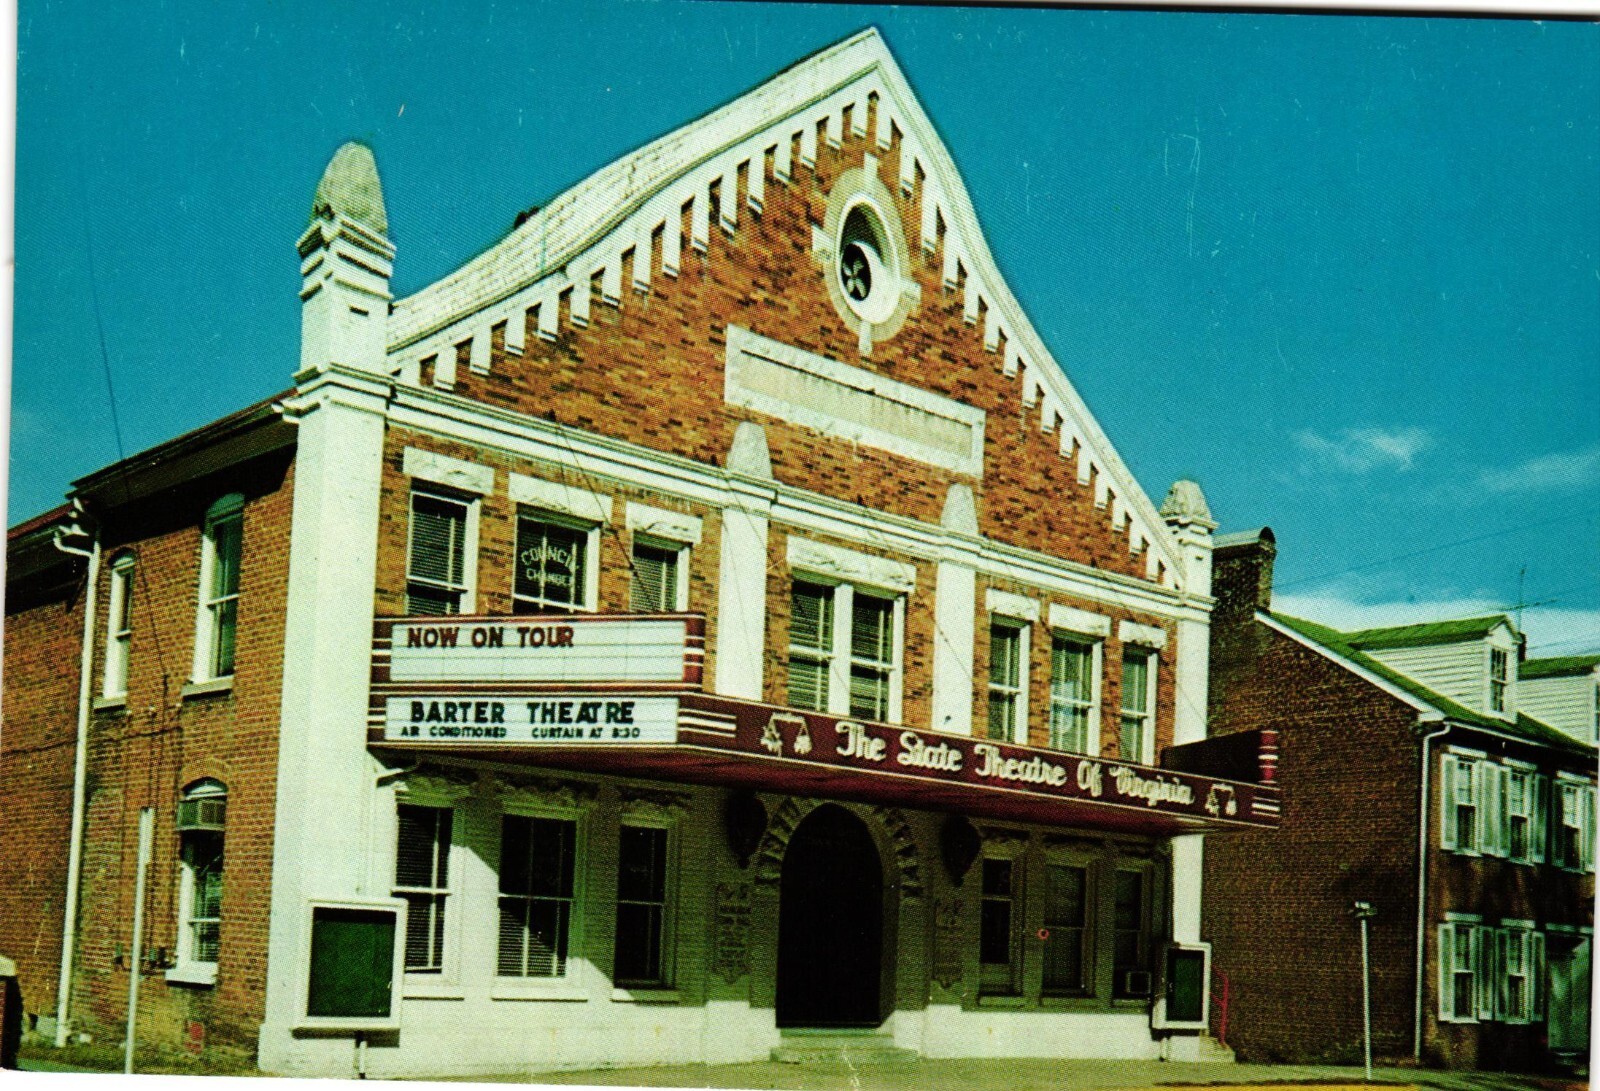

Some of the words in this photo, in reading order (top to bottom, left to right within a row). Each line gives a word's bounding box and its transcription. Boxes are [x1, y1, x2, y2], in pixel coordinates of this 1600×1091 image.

[407, 626, 459, 648] NOW
[471, 626, 504, 647] ON
[517, 626, 574, 647] TOUR
[410, 701, 505, 723] BARTER
[527, 702, 635, 724] THEATRE
[401, 726, 420, 737] AIR
[430, 726, 507, 738] CONDITIONED
[531, 727, 583, 738] CURTAIN
[589, 728, 603, 738] AT
[835, 721, 886, 761] The
[897, 731, 963, 771] State
[973, 744, 1067, 786] Theatre
[1077, 760, 1102, 797] Of
[1109, 765, 1195, 806] Virginia
